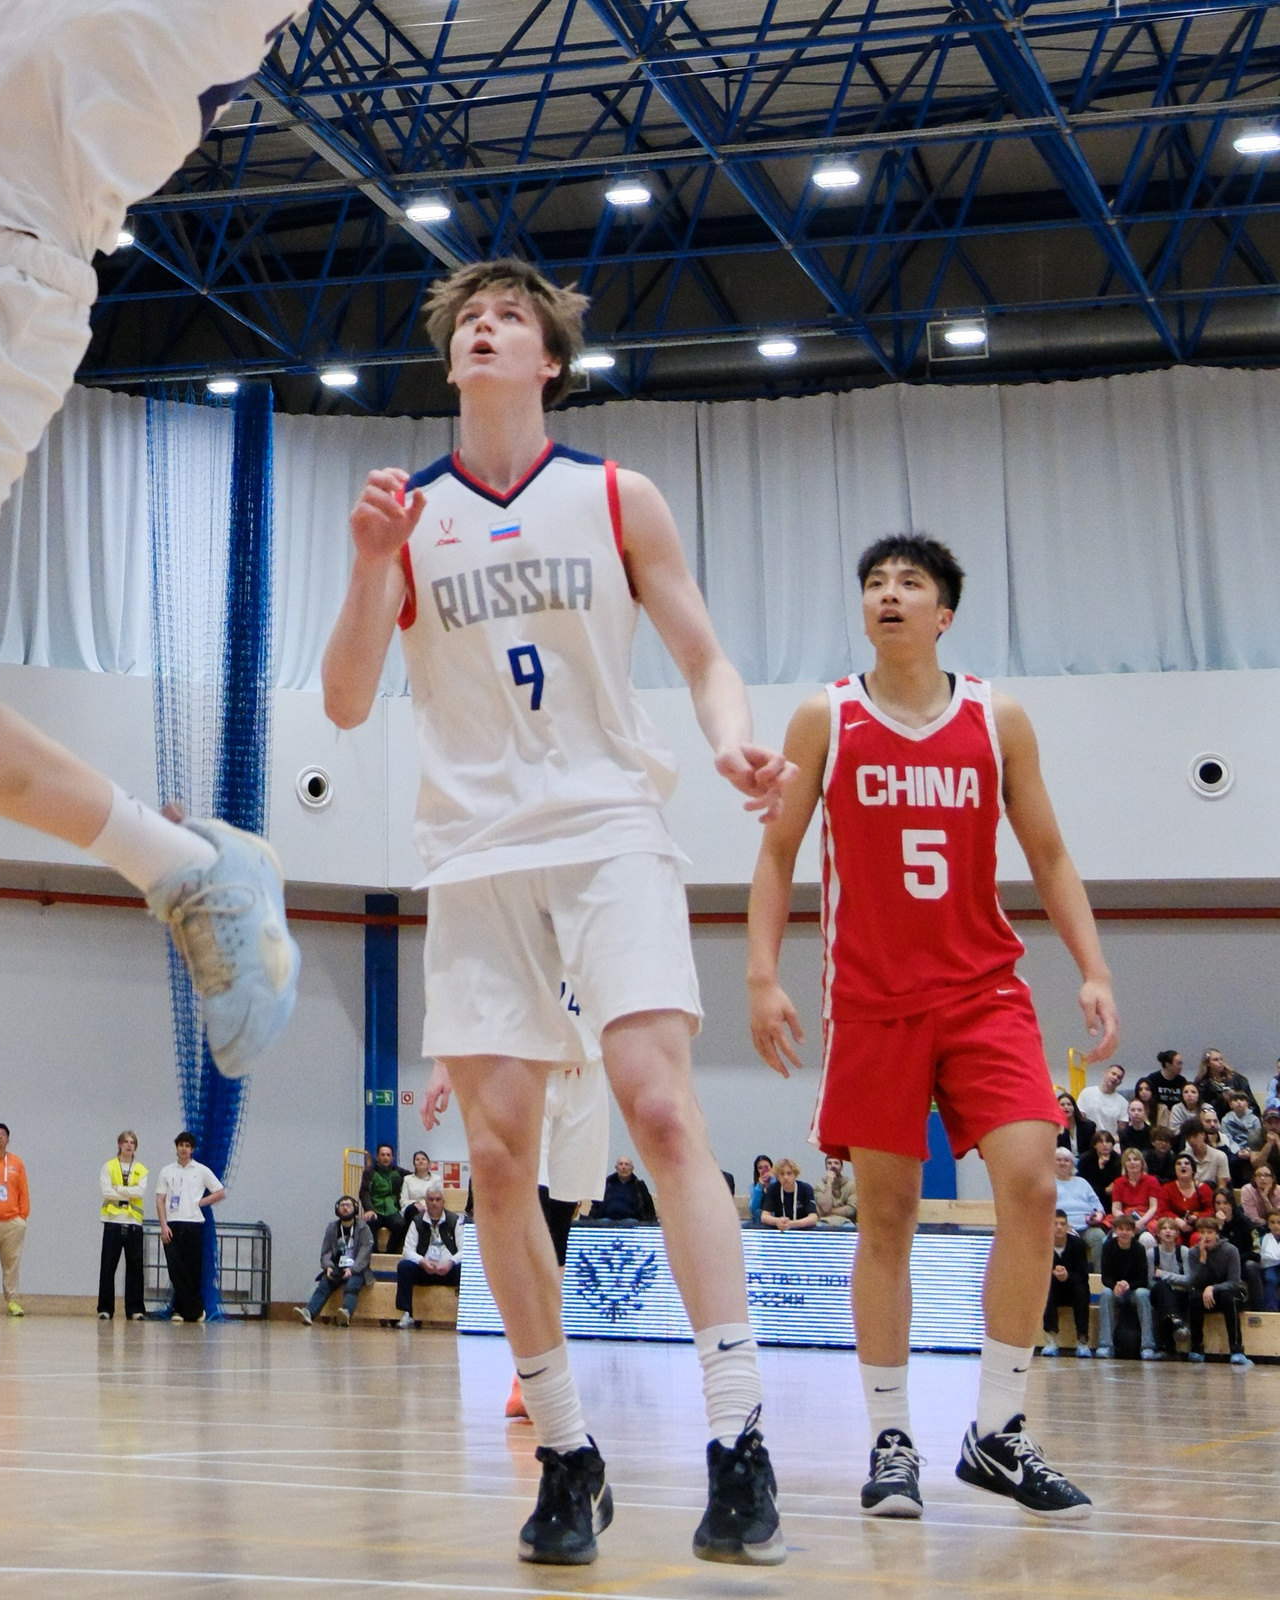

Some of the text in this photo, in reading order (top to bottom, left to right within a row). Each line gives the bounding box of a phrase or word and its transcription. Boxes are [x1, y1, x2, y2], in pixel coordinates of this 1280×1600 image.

[431, 557, 593, 632] RUSSIA
[507, 644, 545, 710] 9
[855, 765, 980, 809] CHINA
[901, 829, 949, 900] 5
